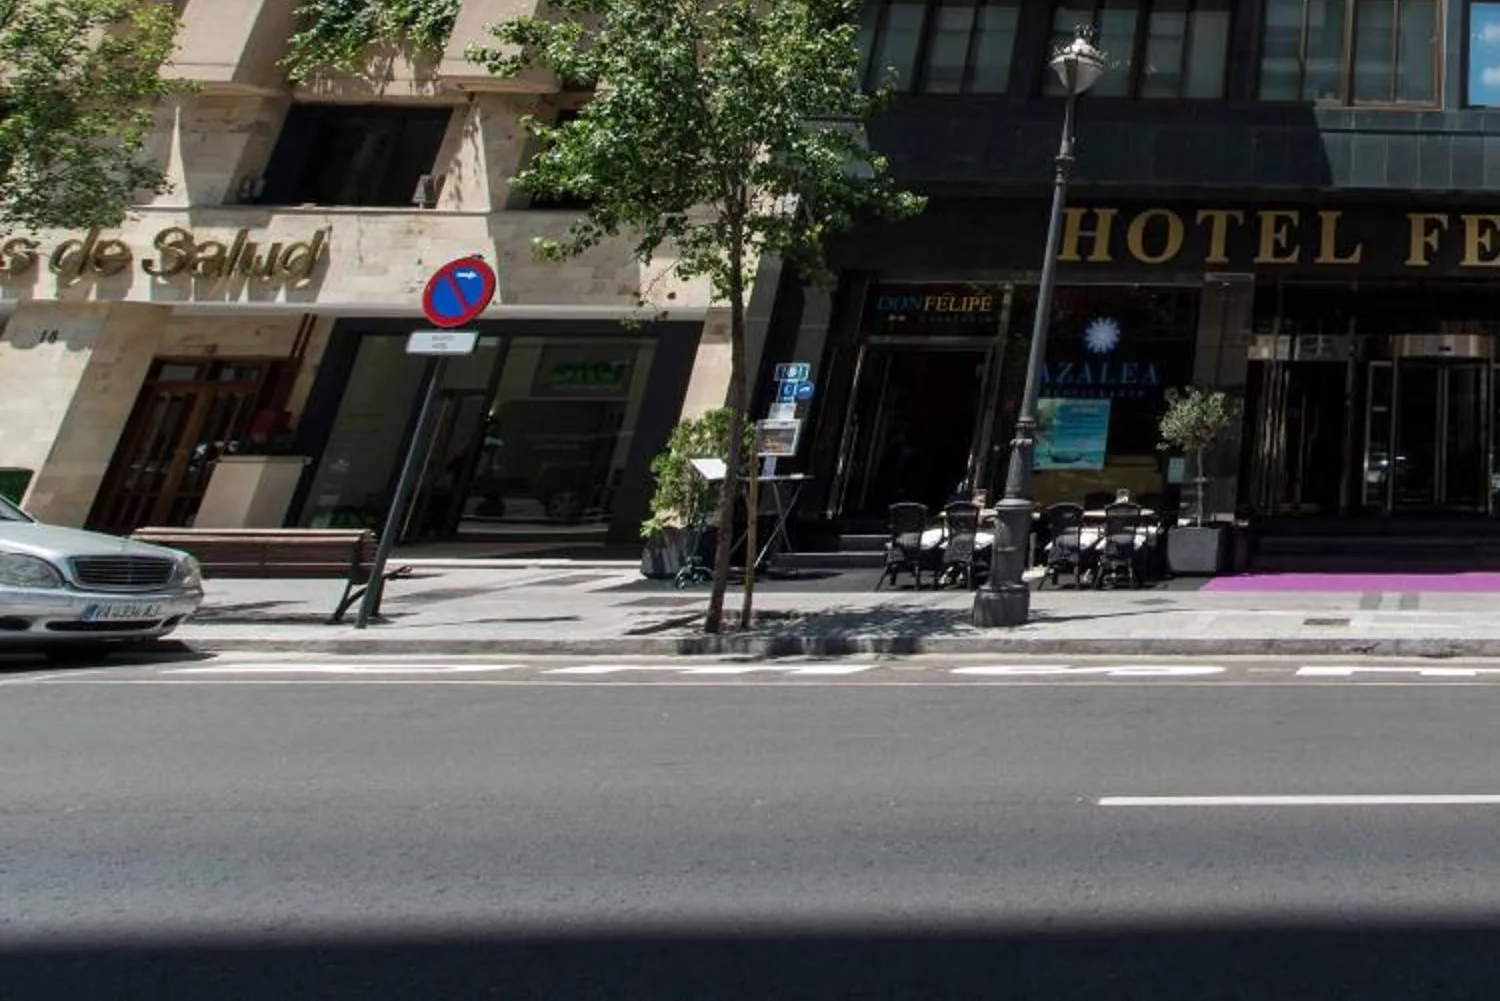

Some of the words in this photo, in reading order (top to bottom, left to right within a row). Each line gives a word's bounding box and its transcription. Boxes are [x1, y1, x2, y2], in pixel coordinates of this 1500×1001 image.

[49, 226, 133, 277] de
[142, 226, 326, 278] Salud
[1056, 207, 1363, 265] HOTEL
[39, 328, 59, 343] 18
